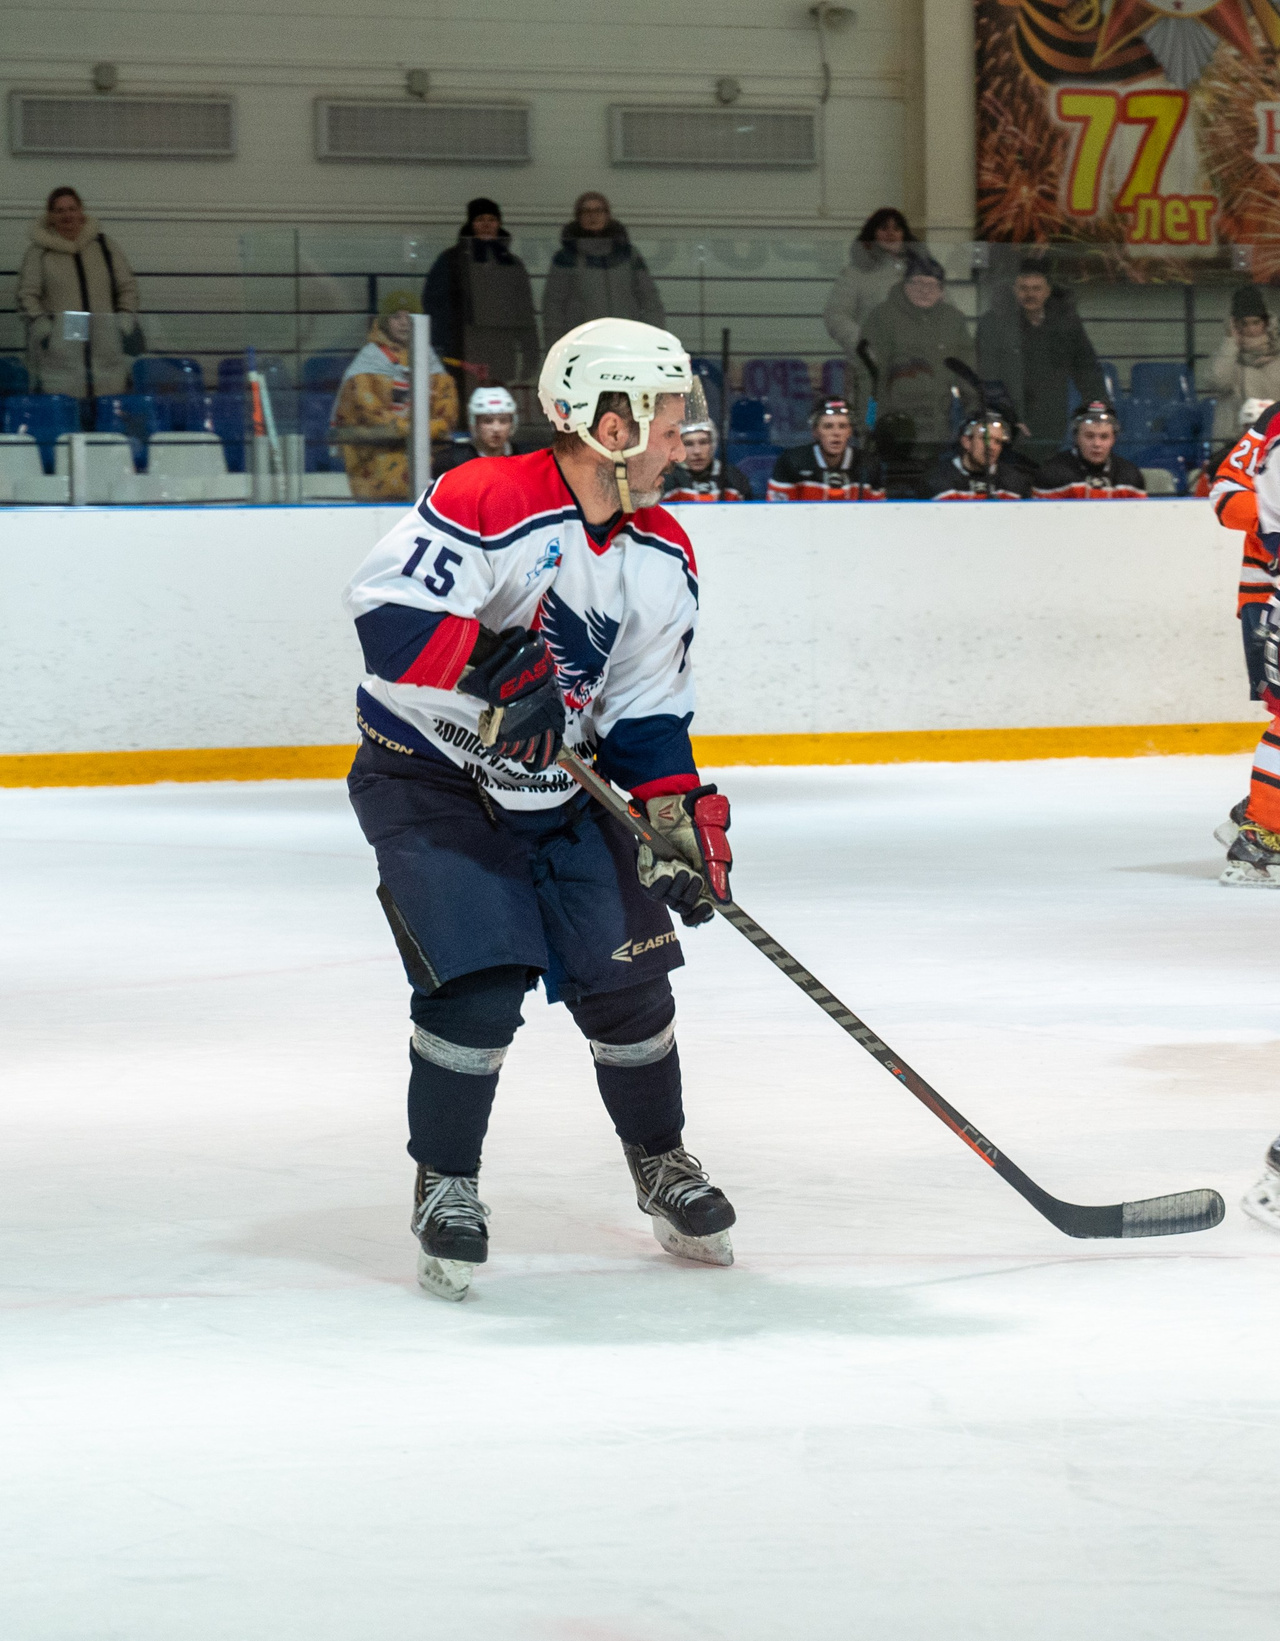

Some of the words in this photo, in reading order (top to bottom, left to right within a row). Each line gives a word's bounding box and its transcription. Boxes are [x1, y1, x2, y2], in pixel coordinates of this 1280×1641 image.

[1057, 87, 1188, 216] 77
[1129, 198, 1216, 246] лет
[600, 373, 636, 382] CCM
[1229, 439, 1260, 478] 21
[401, 536, 463, 597] 15
